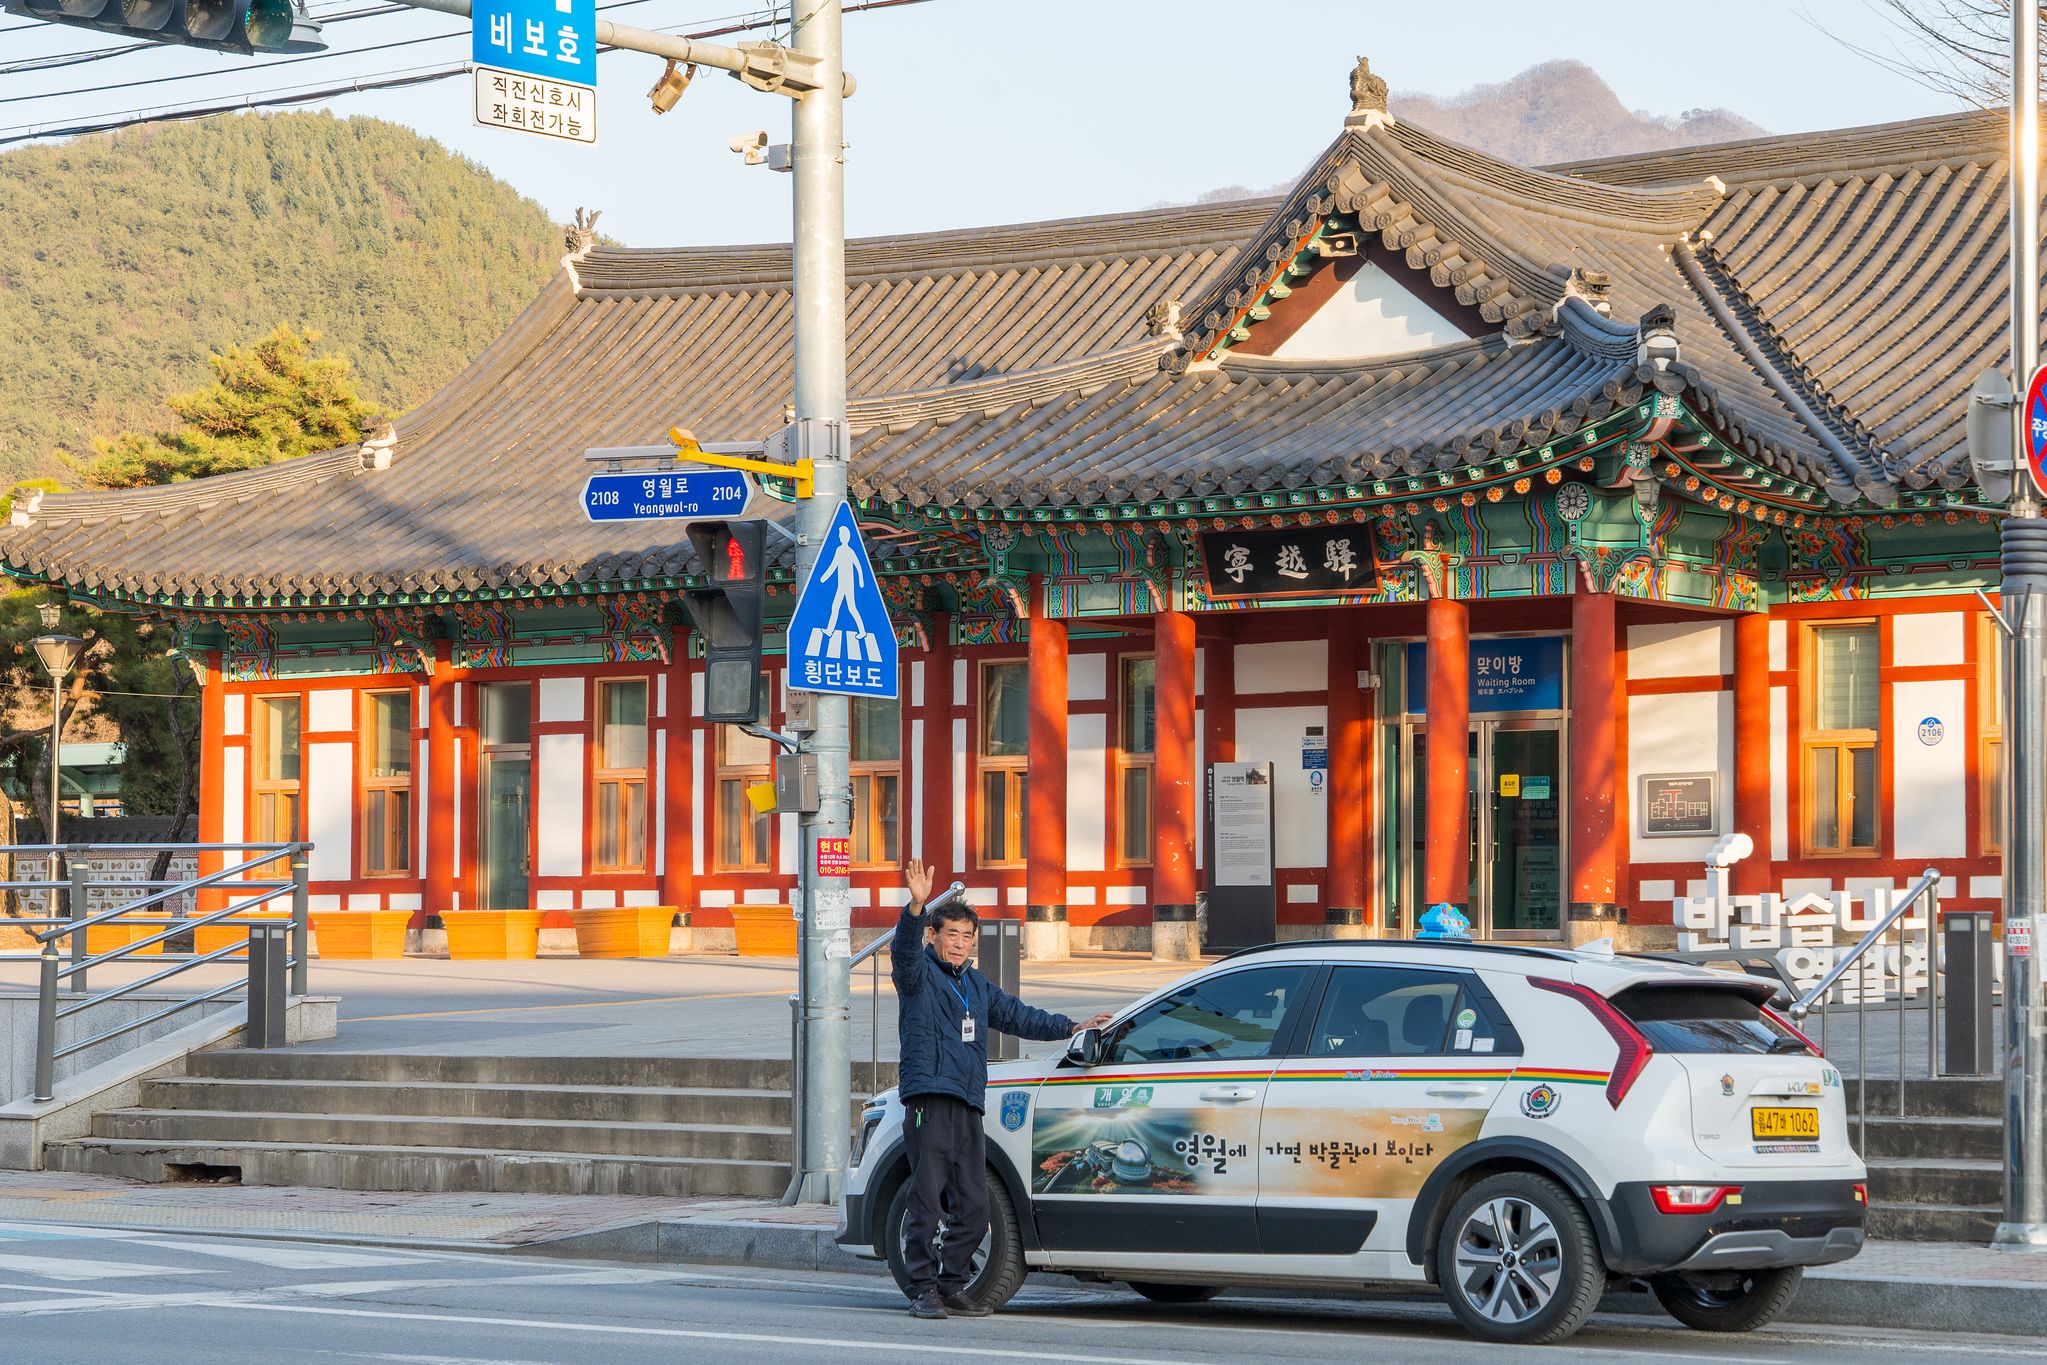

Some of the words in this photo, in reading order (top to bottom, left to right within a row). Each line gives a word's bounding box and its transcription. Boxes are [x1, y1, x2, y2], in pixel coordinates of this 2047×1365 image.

[490, 13, 581, 65] 비보호
[492, 76, 582, 112] 직진신호시
[492, 103, 582, 137] 좌회전가능
[591, 491, 619, 506] 2108
[642, 477, 689, 499] 영월로
[712, 486, 742, 501] 2104
[633, 501, 699, 517] Yeongwol-ro
[804, 660, 883, 688] 횡단보도
[1477, 655, 1522, 675] 맞이방
[1477, 678, 1509, 688] Waiting
[1512, 677, 1536, 686] Room
[1921, 728, 1942, 737] 2106
[1790, 1111, 1815, 1133] 1062
[1265, 1142, 1301, 1164] 가면
[1309, 1140, 1377, 1170] 박물관이
[1385, 1139, 1434, 1164] 보인다
